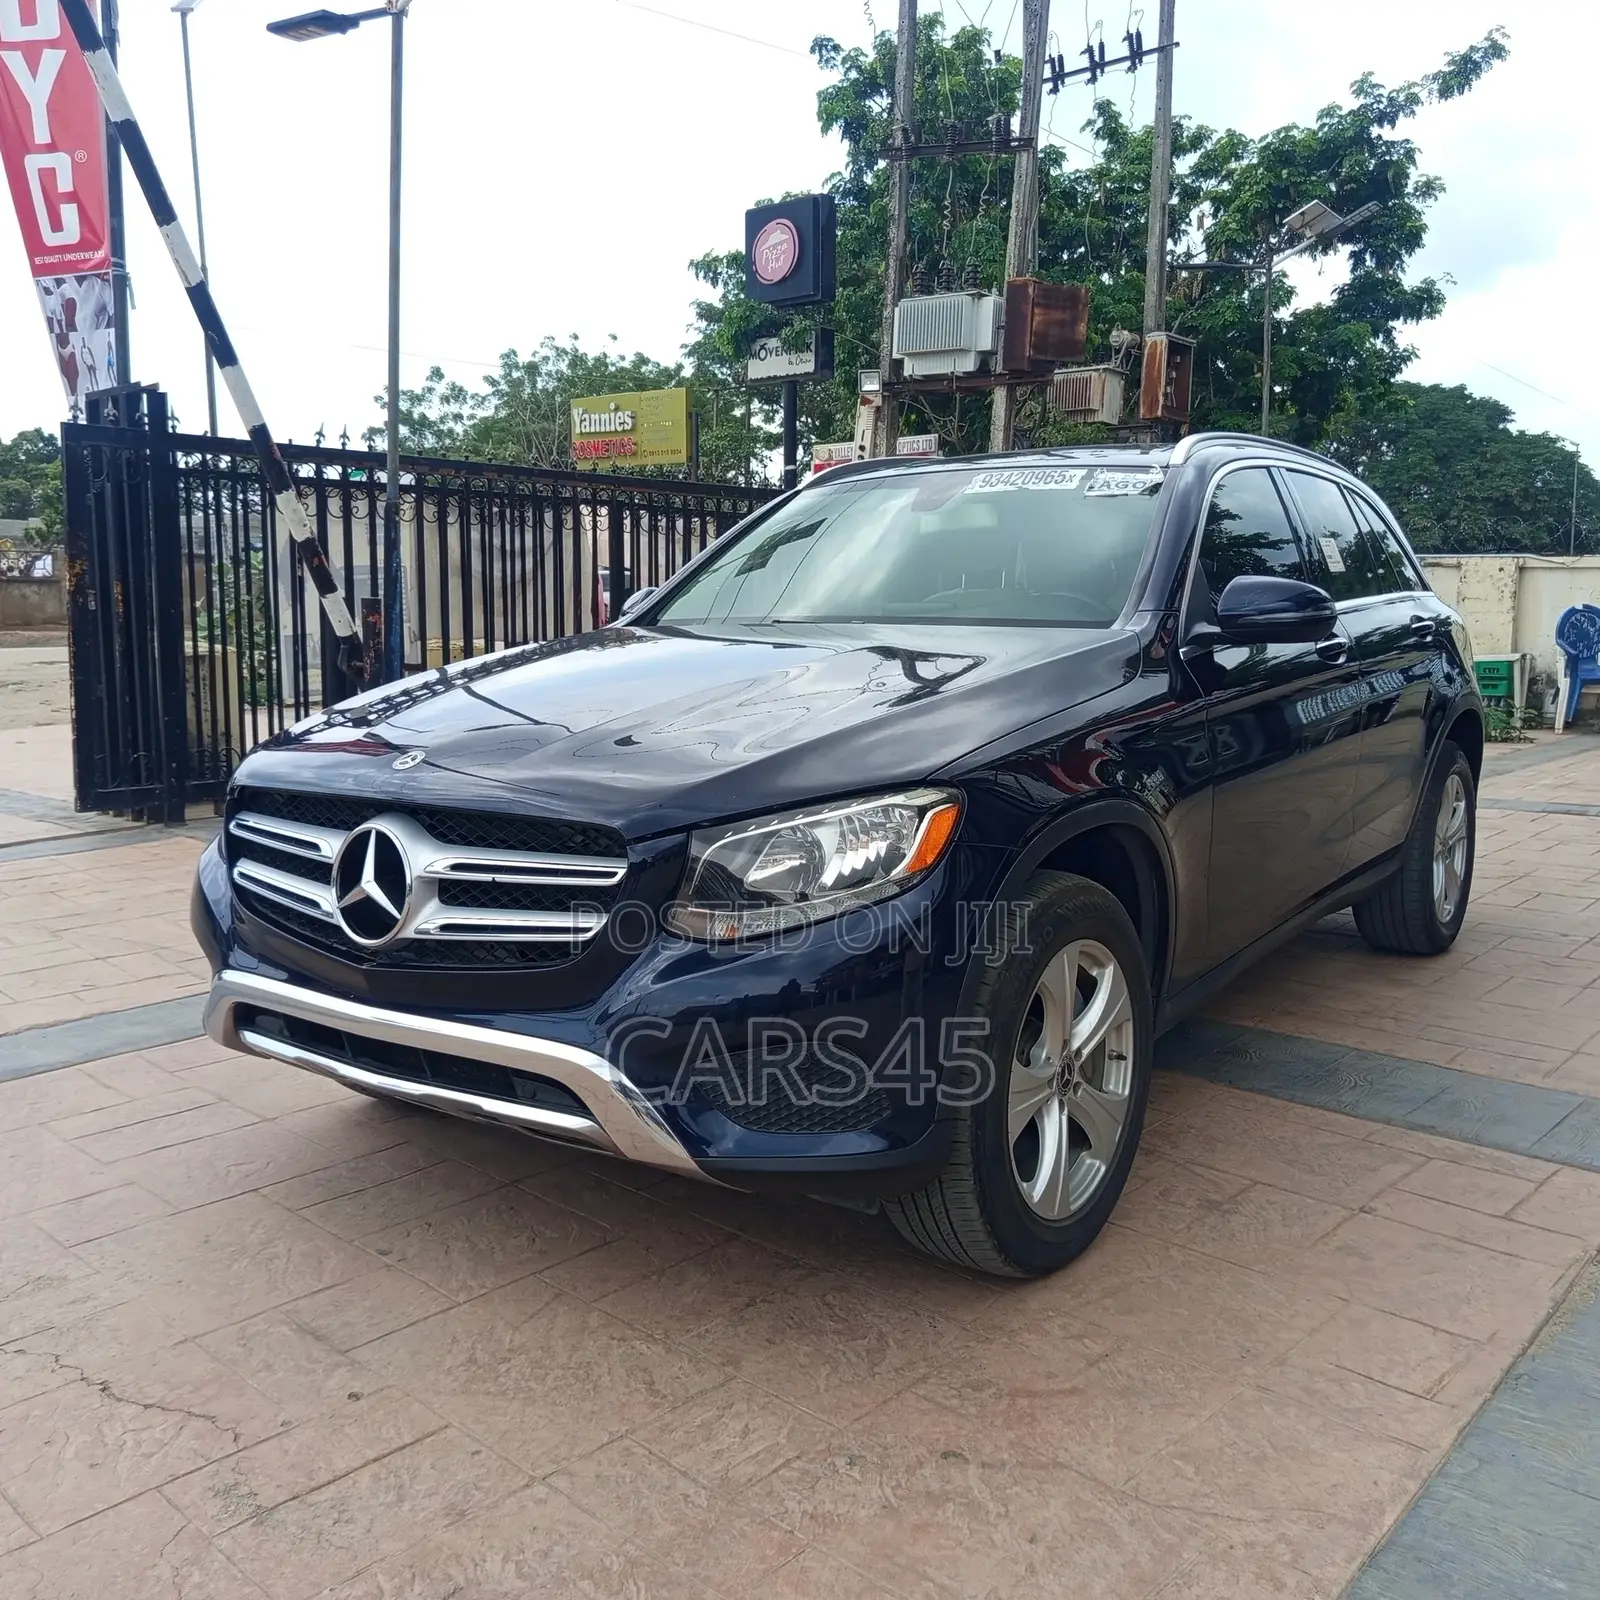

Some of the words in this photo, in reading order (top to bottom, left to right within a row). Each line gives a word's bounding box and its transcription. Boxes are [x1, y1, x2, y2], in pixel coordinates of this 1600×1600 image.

[762, 242, 788, 266] Pizza
[767, 254, 787, 273] Hut
[572, 402, 633, 434] Yannies
[570, 437, 633, 459] COSMETICS
[921, 438, 933, 452] LTD
